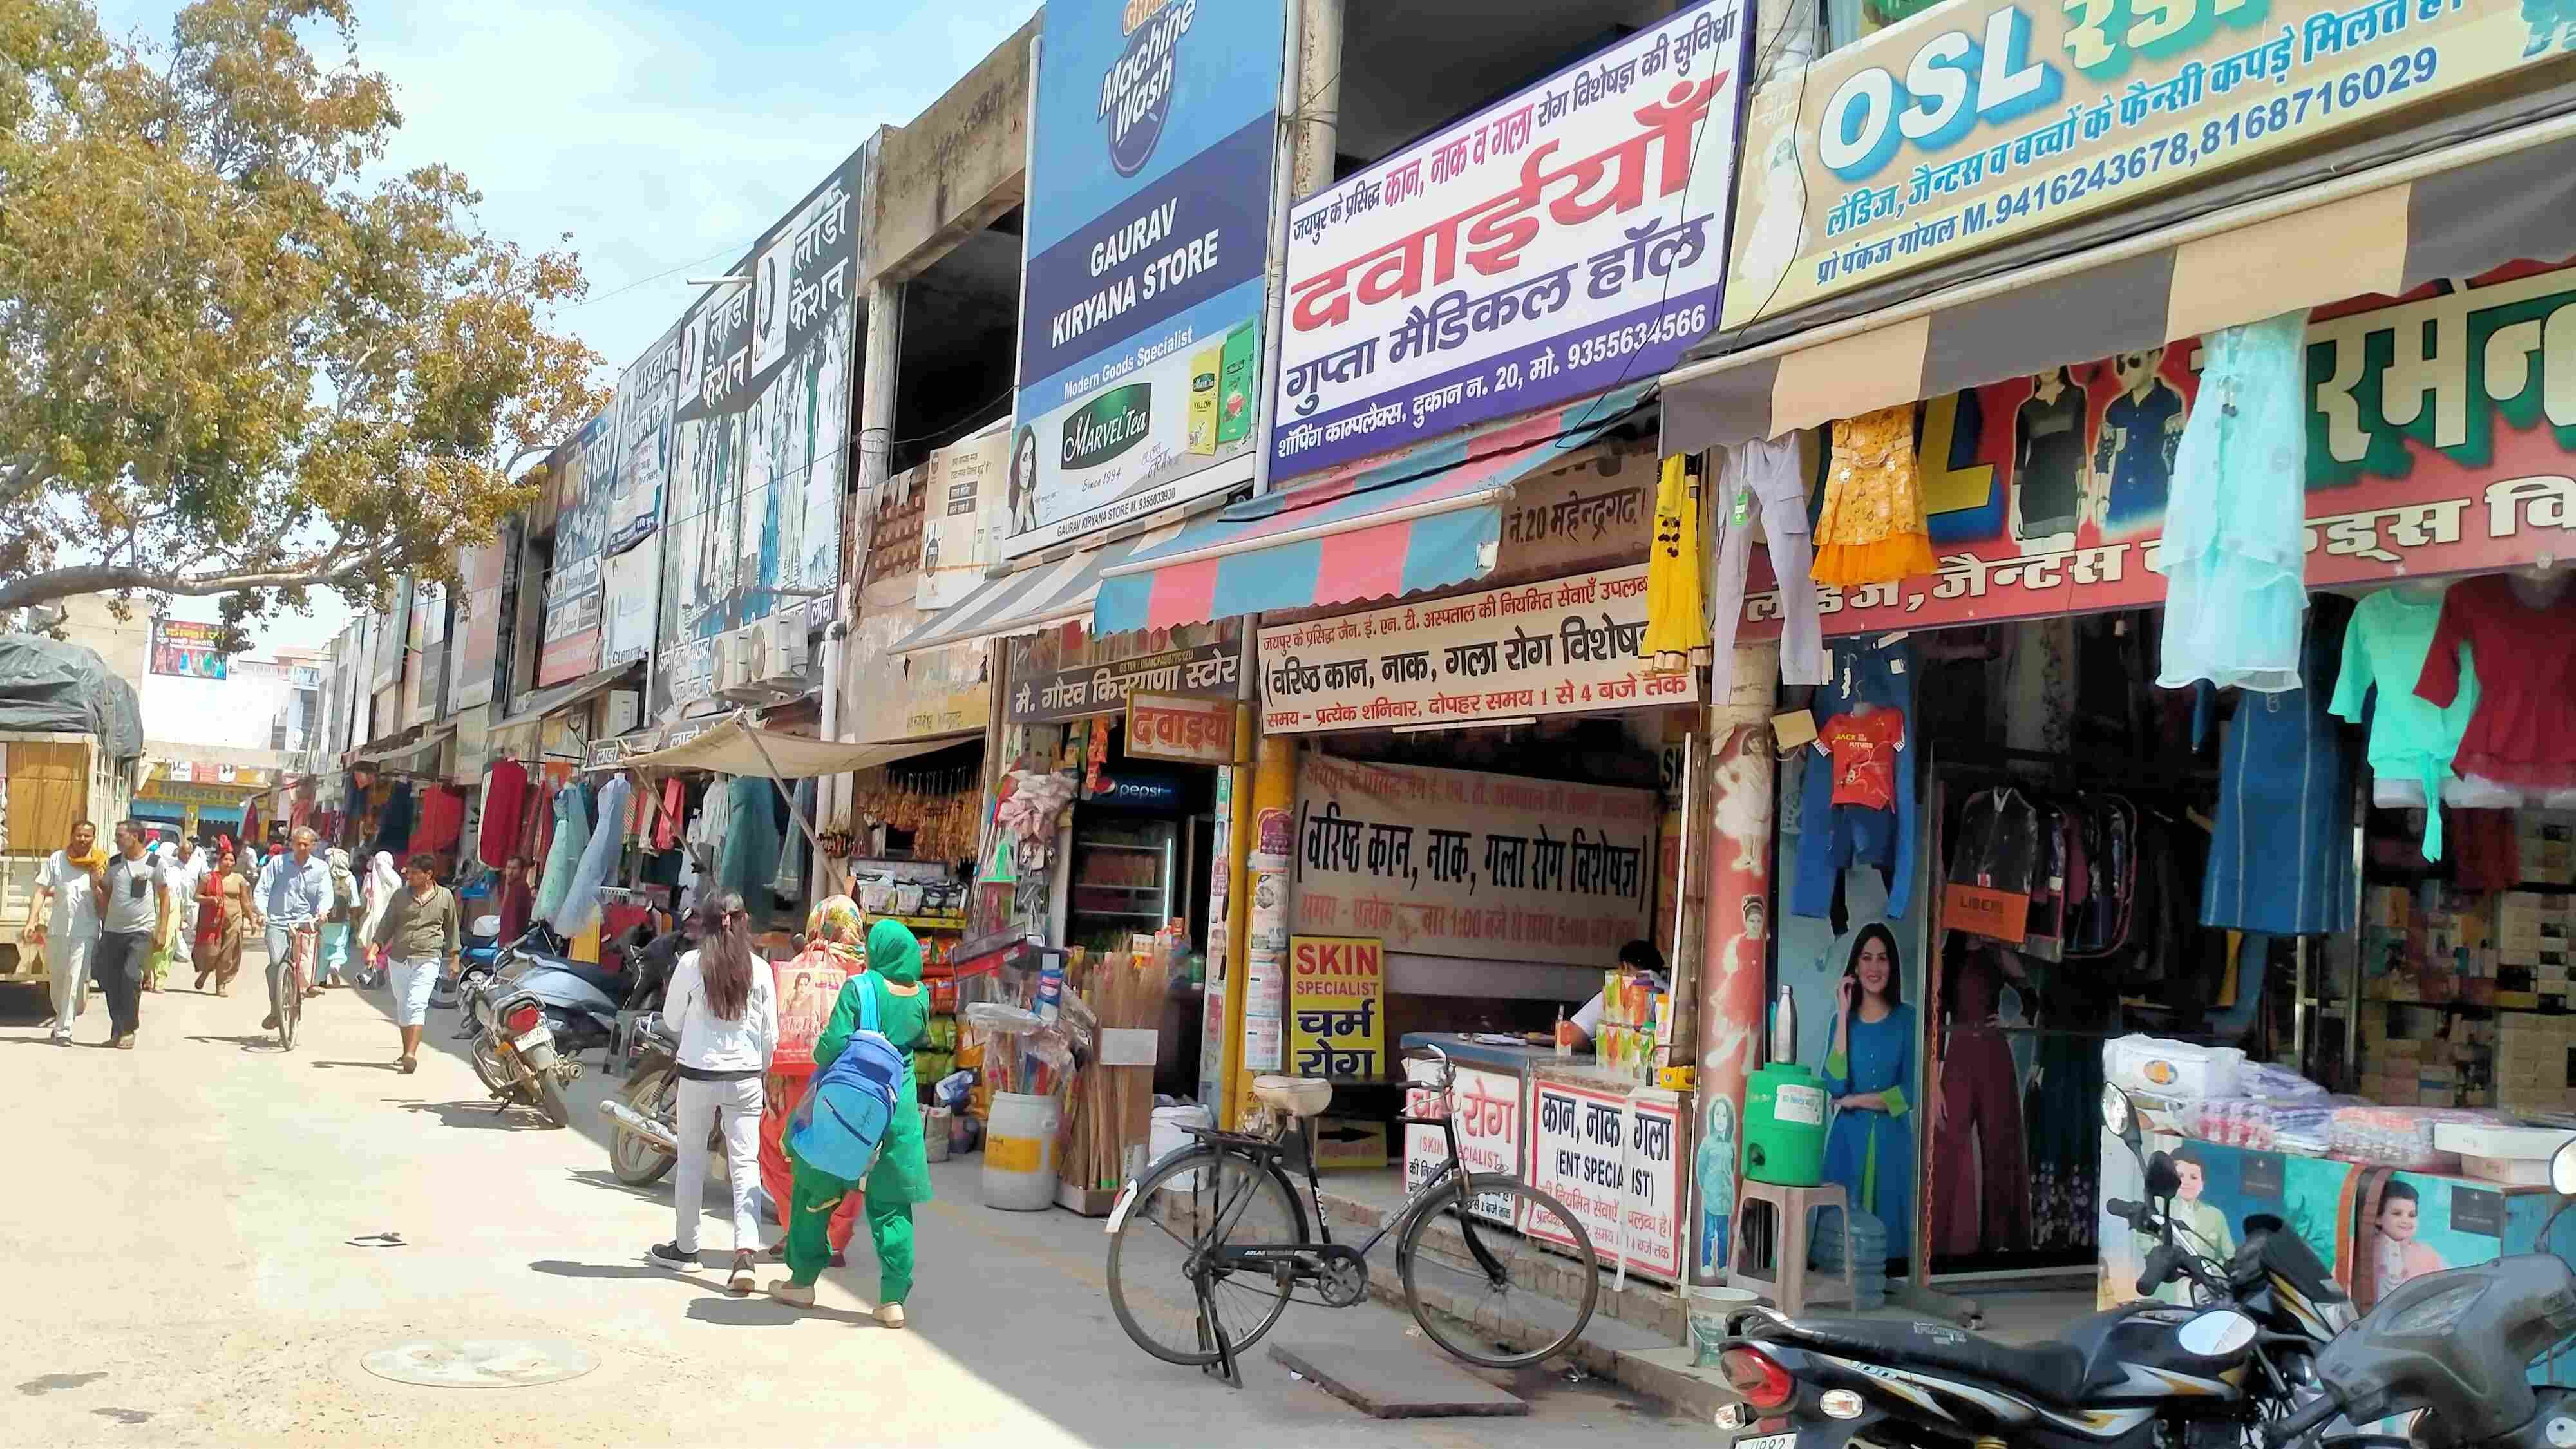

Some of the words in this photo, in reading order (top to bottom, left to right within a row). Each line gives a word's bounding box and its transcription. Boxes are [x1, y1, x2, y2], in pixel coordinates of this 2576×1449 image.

[1098, 0, 1196, 121] Machine
[1115, 52, 1173, 144] Wash
[1819, 5, 2044, 170] OSL
[1991, 141, 2009, 169] व
[2084, 95, 2110, 140] के
[2120, 62, 2206, 125] फैन्सी
[2211, 26, 2295, 94] कपड़े
[2304, 0, 2407, 62] मिलत
[1293, 206, 1329, 245] जयपुर
[1330, 195, 1341, 223] के
[1345, 178, 1382, 223] प्रसिद्ध
[1385, 165, 1425, 207] कान,
[1430, 136, 1469, 183] नाक
[1473, 133, 1486, 165] व
[1490, 104, 1533, 156] गला
[1537, 91, 1568, 128] रोग
[1573, 61, 1636, 109] विशेषज्ञ
[1642, 34, 1669, 73] की
[1674, 9, 1738, 77] सुविधा
[1842, 240, 1891, 276] पंकज
[1899, 217, 1955, 256] गोयल
[1962, 46, 2438, 238] M.9416243678,8168716029
[1090, 198, 1178, 278] GAURAV
[1291, 68, 1732, 334] दवाईयाँ
[790, 256, 849, 332] फैशन
[1051, 281, 1137, 350] KIRYANA
[1142, 229, 1219, 298] STORE
[1287, 336, 1381, 417] गुप्ता
[1389, 263, 1580, 365] मैडिकल
[1587, 213, 1714, 300] हॉल
[1064, 369, 1099, 400] Modern
[1102, 353, 1135, 386] Goods
[1137, 325, 1193, 366] Specialist
[1278, 422, 1321, 459] शॉपिंग
[1325, 401, 1406, 444] काम्पलैक्स,
[1412, 380, 1463, 429] दुकान
[1466, 375, 1489, 401] न.
[1495, 365, 1524, 395] 20,
[1528, 352, 1560, 382] मो.
[1567, 302, 1707, 371] 9355634566
[1057, 518, 1081, 537] GAURAV
[1081, 509, 1107, 529] KIRYANA
[1108, 500, 1129, 520] STORE
[1081, 478, 1102, 493] Since
[1263, 635, 1291, 657] जयपुर
[1293, 629, 1303, 647] के
[1307, 624, 1335, 648] प्रसिद्ध
[1337, 619, 1361, 640] जैन.
[1364, 614, 1376, 638] ई.
[1380, 616, 1401, 635] एन.
[1404, 608, 1419, 631] टी.
[1423, 603, 1477, 629] अस्पताल
[1478, 593, 1496, 619] की
[1500, 587, 1553, 616] नियमित
[1557, 576, 1596, 607] सेवाएँ
[1599, 575, 1649, 601] उपलब्
[1324, 659, 1375, 689] कान,
[1381, 650, 1437, 683] नाक,
[1444, 641, 1498, 677] गला
[1504, 625, 1553, 671] रोग
[1560, 612, 1649, 665] विशेष
[1015, 681, 1036, 714] मै.
[1185, 648, 1239, 689] स्टोर
[1267, 711, 1299, 728] समय
[1316, 702, 1357, 726] प्रत्येक
[1361, 697, 1423, 721] शनिवार,
[1428, 692, 1481, 715] दोपहर
[1486, 689, 1534, 710] समय
[1555, 678, 1575, 705] से
[1580, 684, 1592, 701] 4
[1597, 672, 1638, 701] बजे
[1643, 674, 1689, 697] तक
[1119, 783, 1163, 798] pepsi
[1367, 822, 1419, 891] कान,
[1427, 829, 1477, 896] नाक,
[1485, 834, 1528, 888] गला
[1531, 824, 1568, 894] रोग
[1296, 943, 1379, 976] SKIN
[1296, 980, 1379, 996] SPECIALIST
[1296, 998, 1376, 1038] चर्म
[1296, 1039, 1376, 1074] रोग
[1463, 1076, 1514, 1144] रोग
[1542, 1092, 1580, 1144] कान,
[1633, 1112, 1672, 1161] गला
[1556, 1148, 1581, 1180] (ENT
[1584, 1155, 1654, 1206] SPECIAIST)
[1628, 1210, 1656, 1232] पलब्ध
